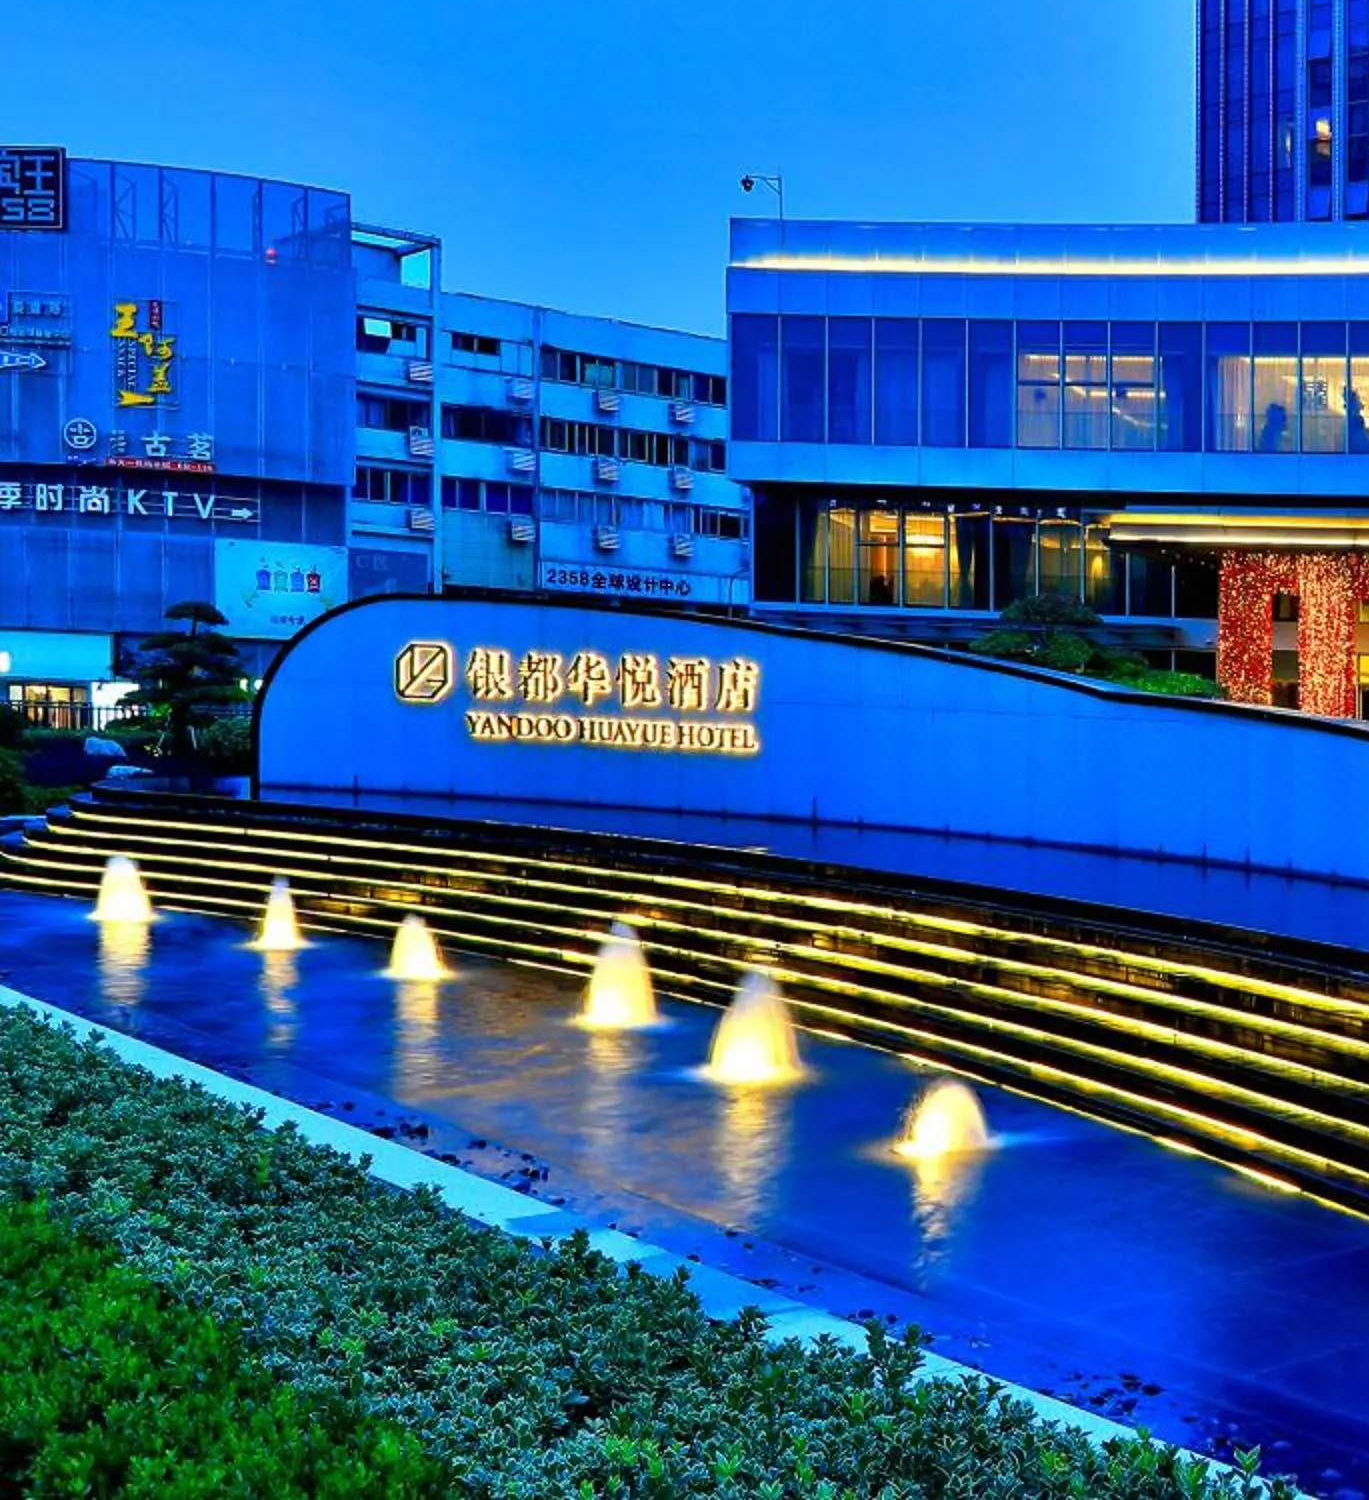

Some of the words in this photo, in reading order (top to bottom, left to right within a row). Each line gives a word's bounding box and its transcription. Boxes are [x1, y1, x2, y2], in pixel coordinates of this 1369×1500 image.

[140, 430, 214, 460] 古茗
[546, 568, 691, 596] 2358全球设计中心
[465, 648, 758, 711] 银都华悦酒店
[465, 711, 577, 742] YANDOO
[578, 717, 676, 748] HUAYUE
[677, 723, 759, 753] HOTEL
